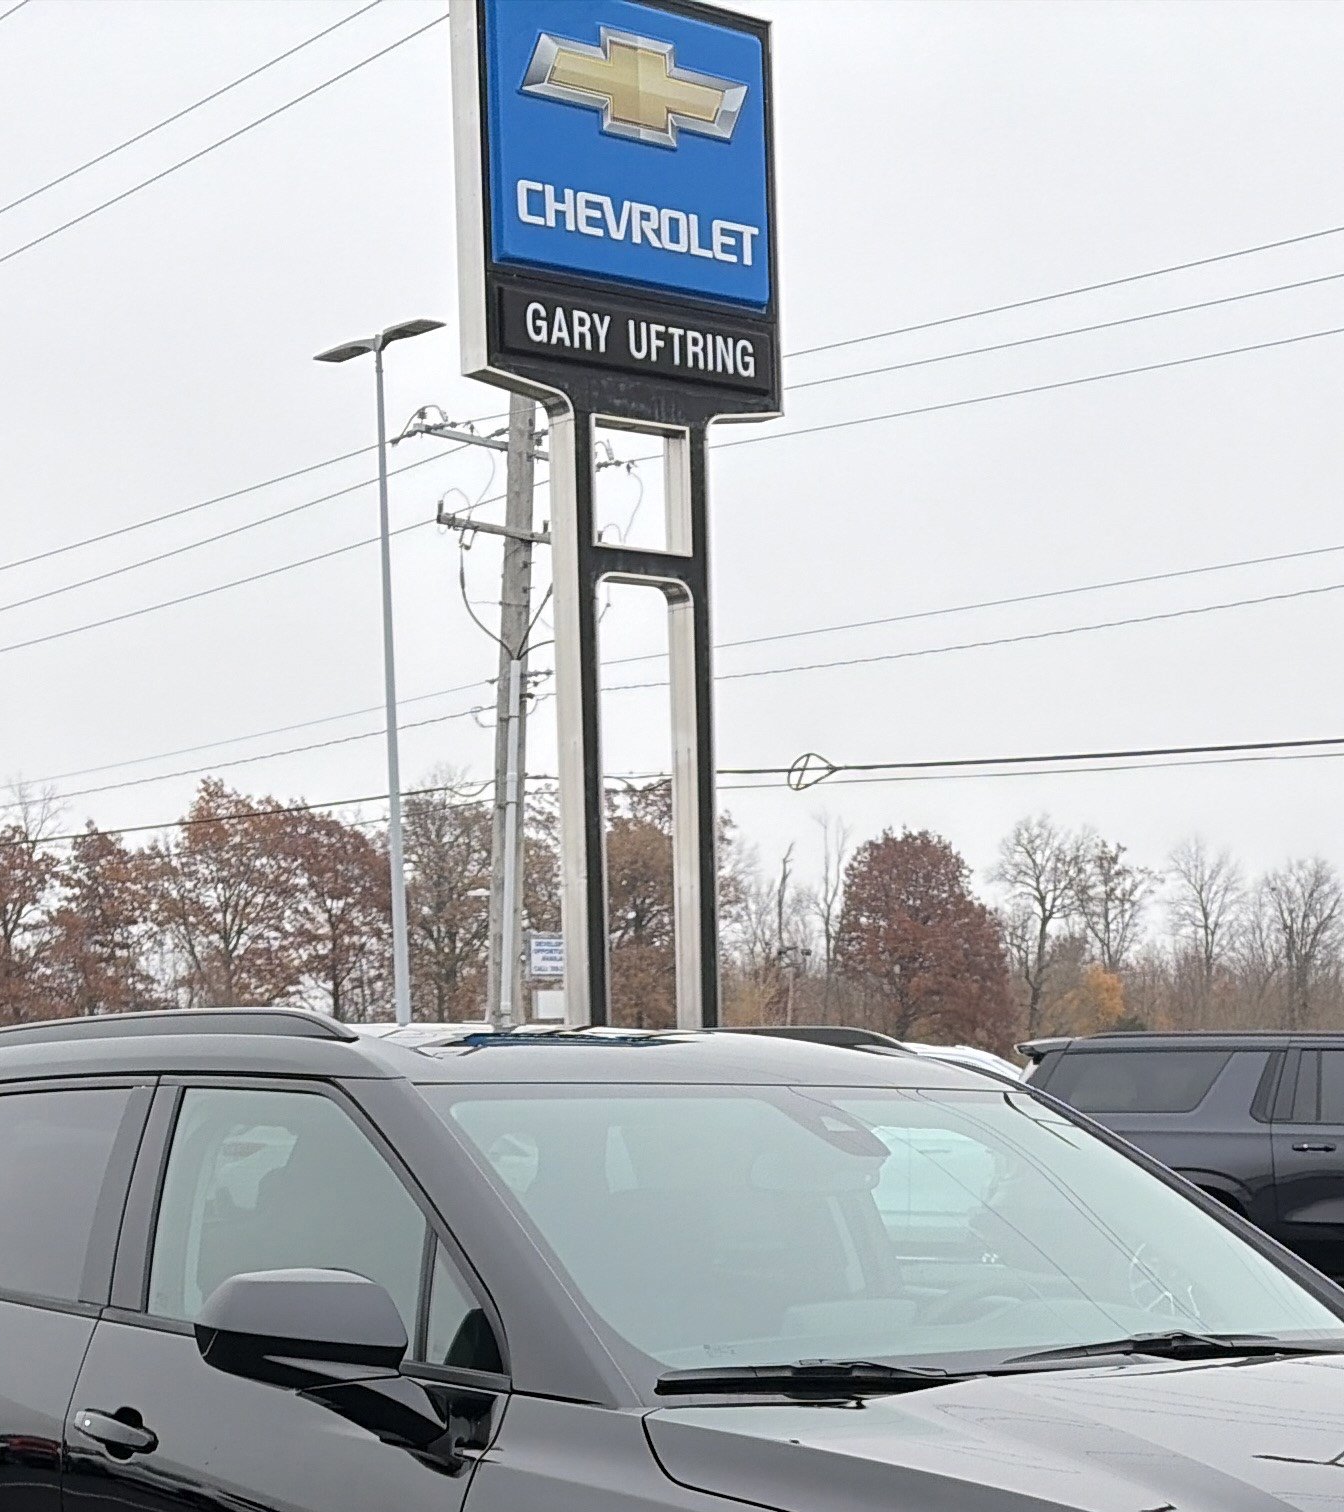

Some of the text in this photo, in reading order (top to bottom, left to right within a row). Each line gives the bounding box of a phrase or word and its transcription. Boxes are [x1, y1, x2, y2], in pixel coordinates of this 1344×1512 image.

[516, 179, 759, 267] CHEVROLET
[526, 302, 756, 378] GARY UFTRING
